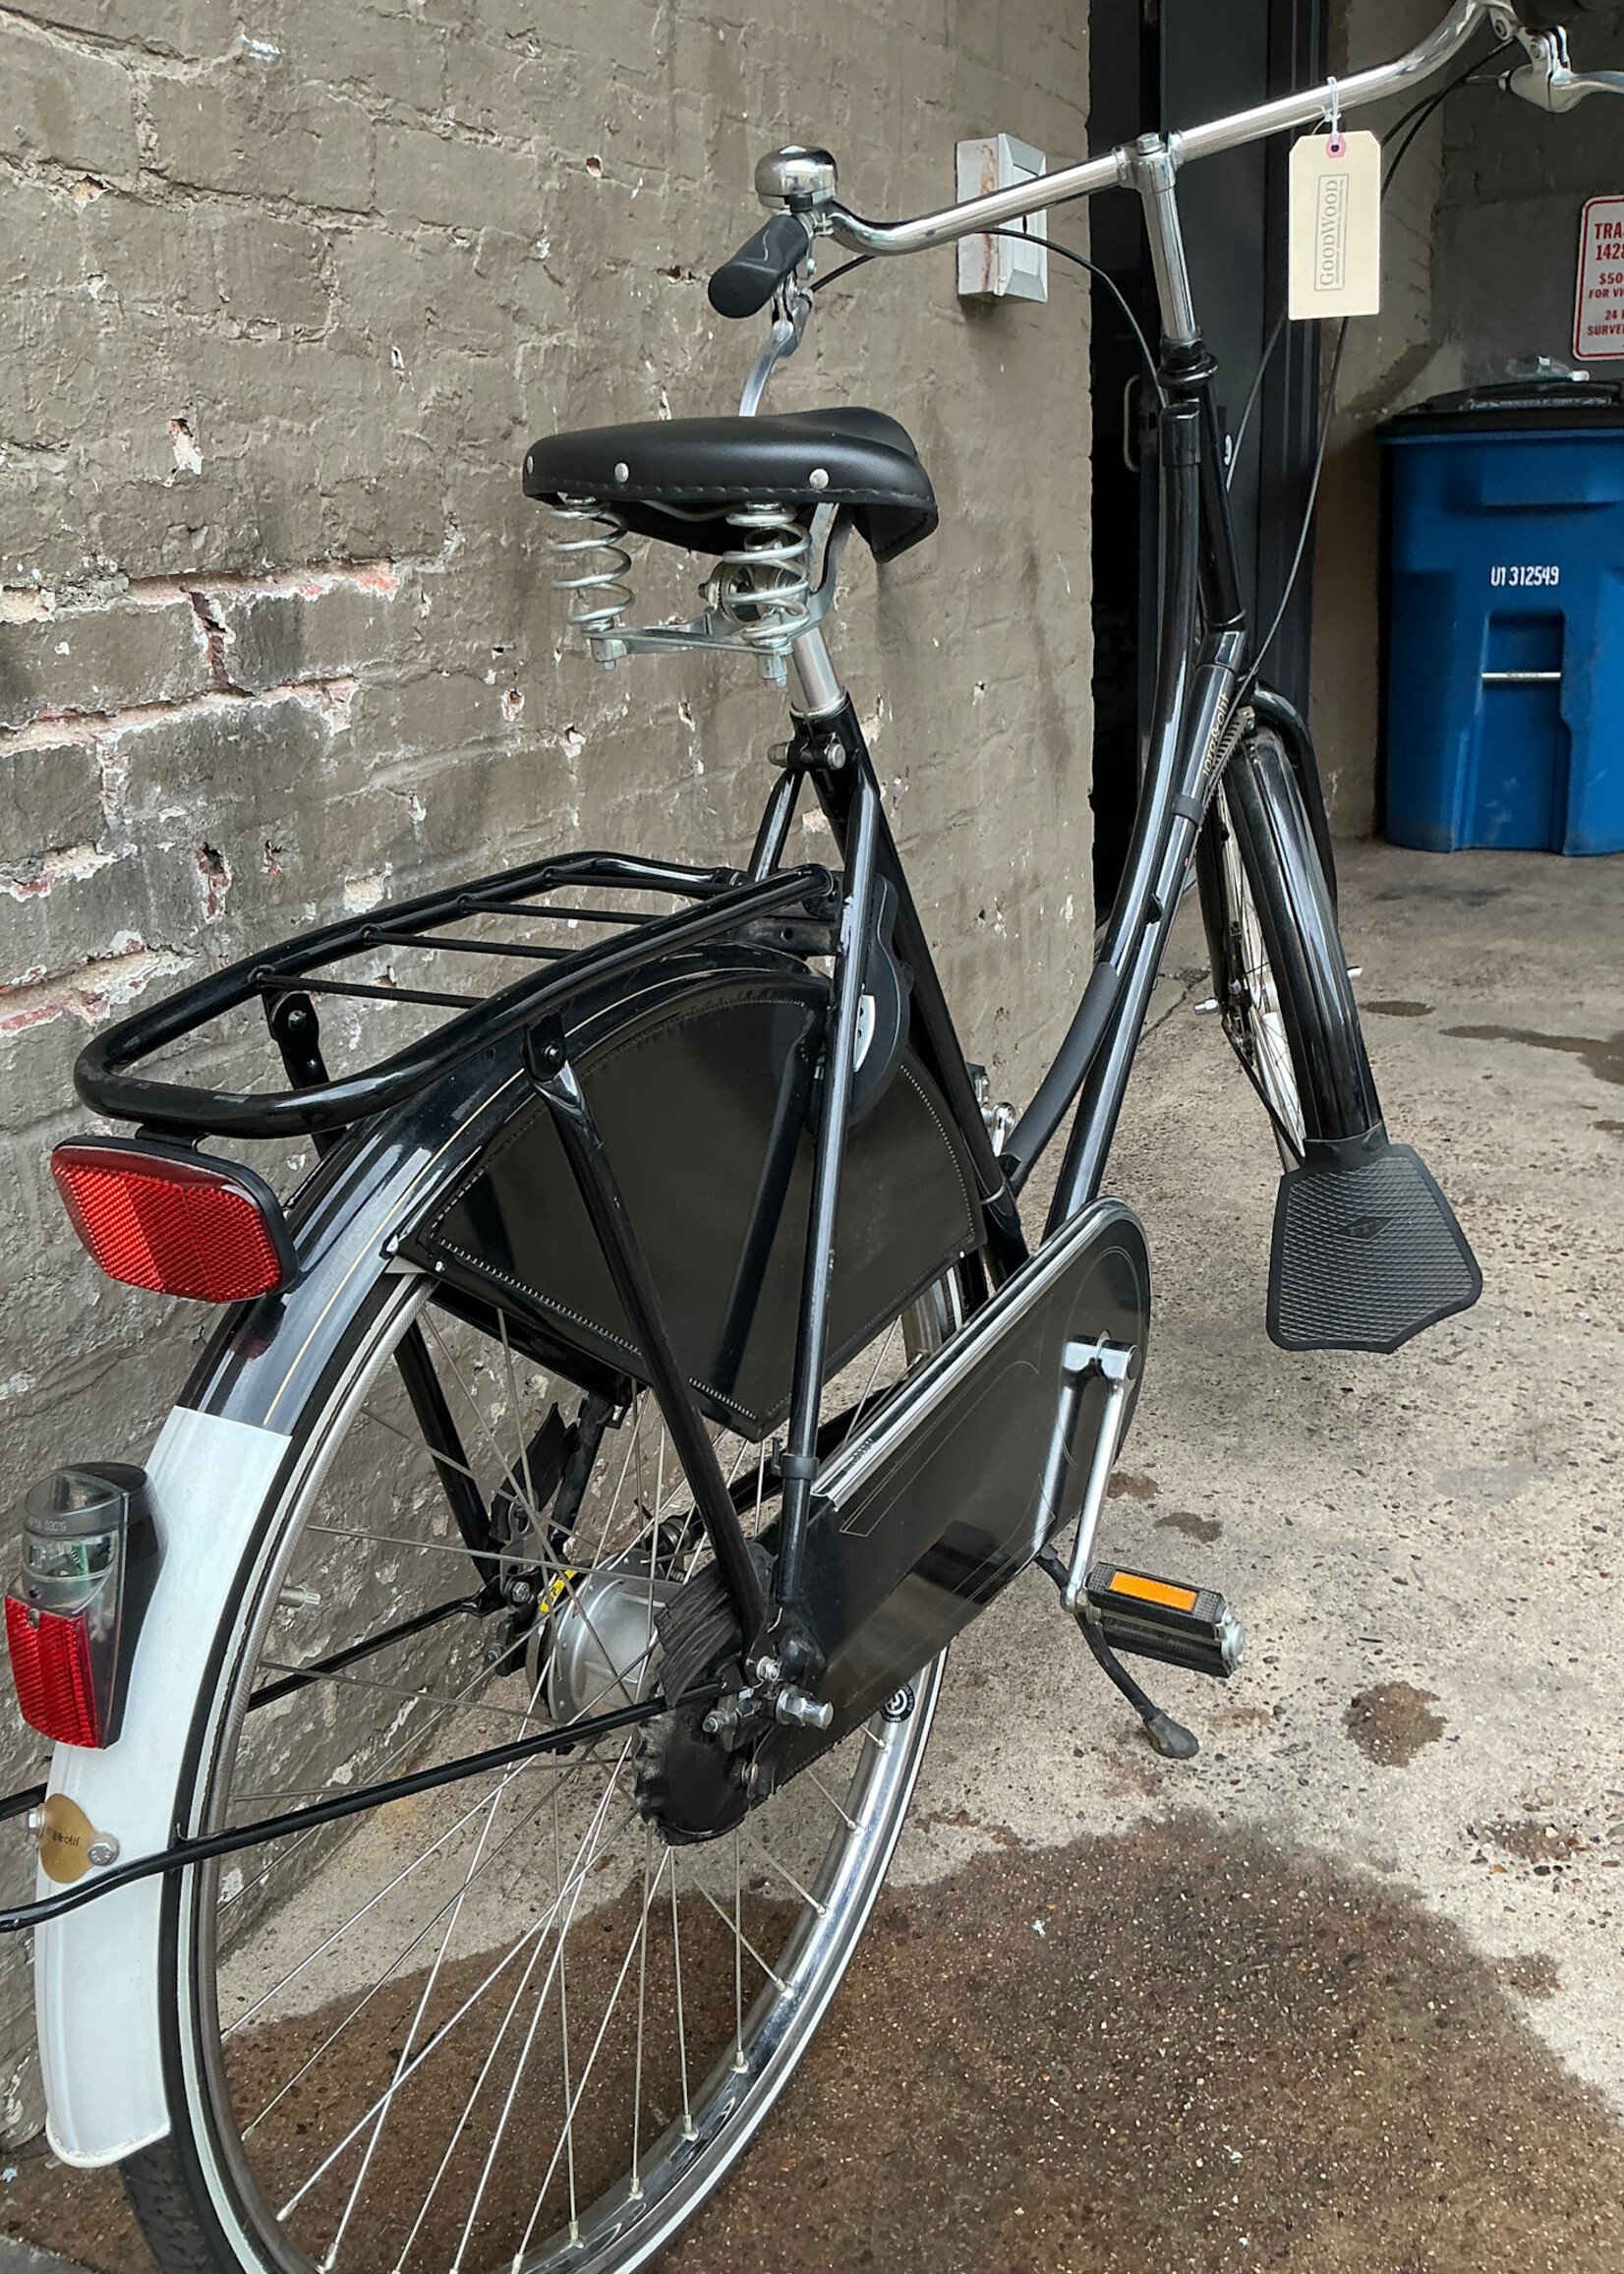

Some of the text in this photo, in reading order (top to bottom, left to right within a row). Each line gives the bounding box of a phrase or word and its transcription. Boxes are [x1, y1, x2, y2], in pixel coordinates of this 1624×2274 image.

[1595, 221, 1624, 240] TRA
[1598, 272, 1624, 285] $50
[1589, 287, 1624, 299] FOR VI
[1604, 310, 1617, 320] 24
[1509, 565, 1560, 587] 312549
